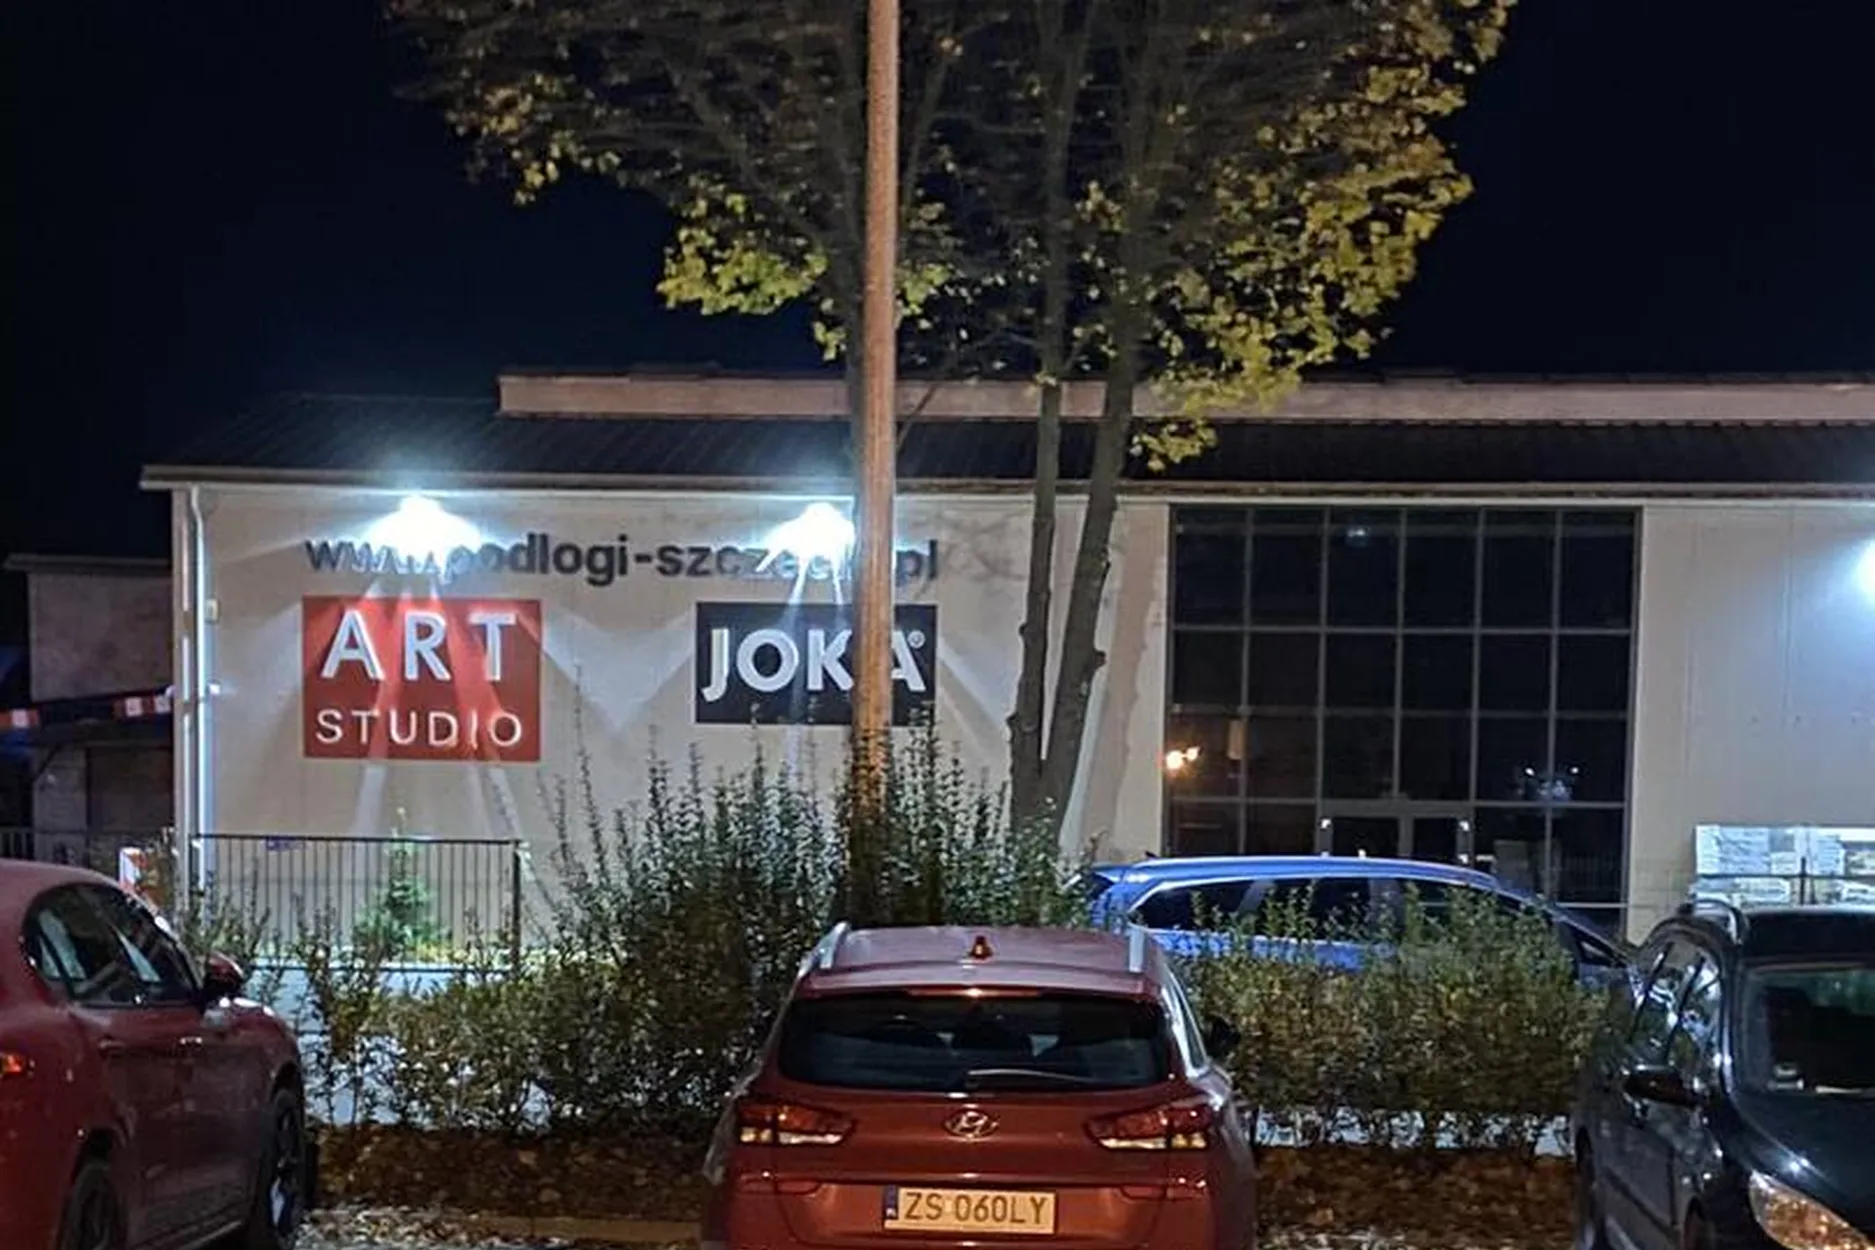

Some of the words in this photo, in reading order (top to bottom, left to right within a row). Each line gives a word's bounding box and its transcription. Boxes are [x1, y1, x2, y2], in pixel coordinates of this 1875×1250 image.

[320, 609, 517, 682] ART
[315, 707, 523, 750] STUDIO
[905, 1191, 943, 1221] ZS
[954, 1194, 1049, 1225] 060LY
